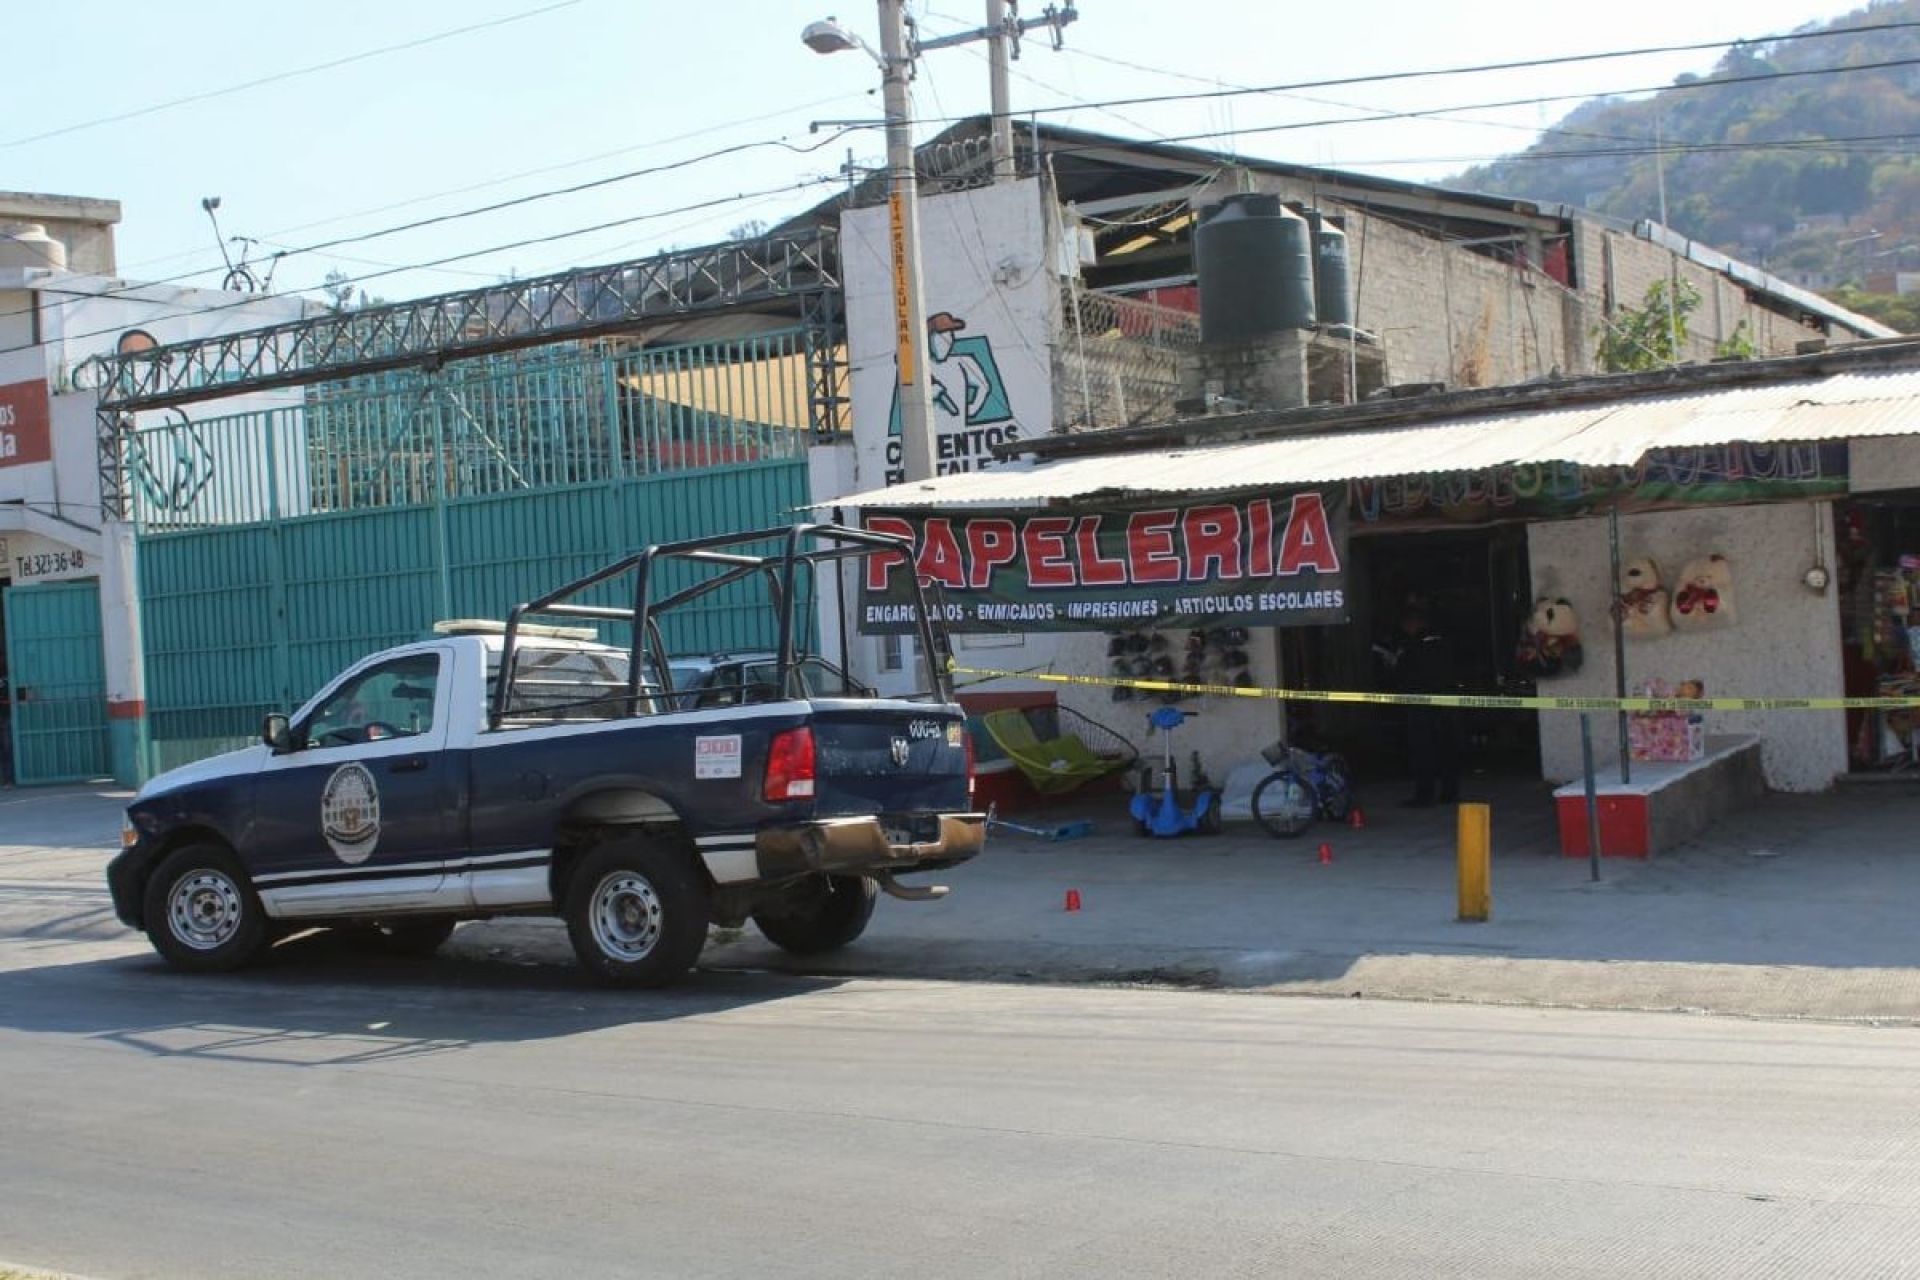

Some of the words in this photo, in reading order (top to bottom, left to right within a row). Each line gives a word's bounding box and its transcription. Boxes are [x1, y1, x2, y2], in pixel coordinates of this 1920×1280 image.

[886, 424, 1020, 465] CENTOS
[866, 492, 1340, 590] PAPELERIA
[977, 602, 1055, 621] ENMICADOS
[1068, 599, 1158, 618] IMPRESIONES
[1175, 594, 1253, 614] ARTICULOS
[1259, 589, 1344, 610] ESCOLARES
